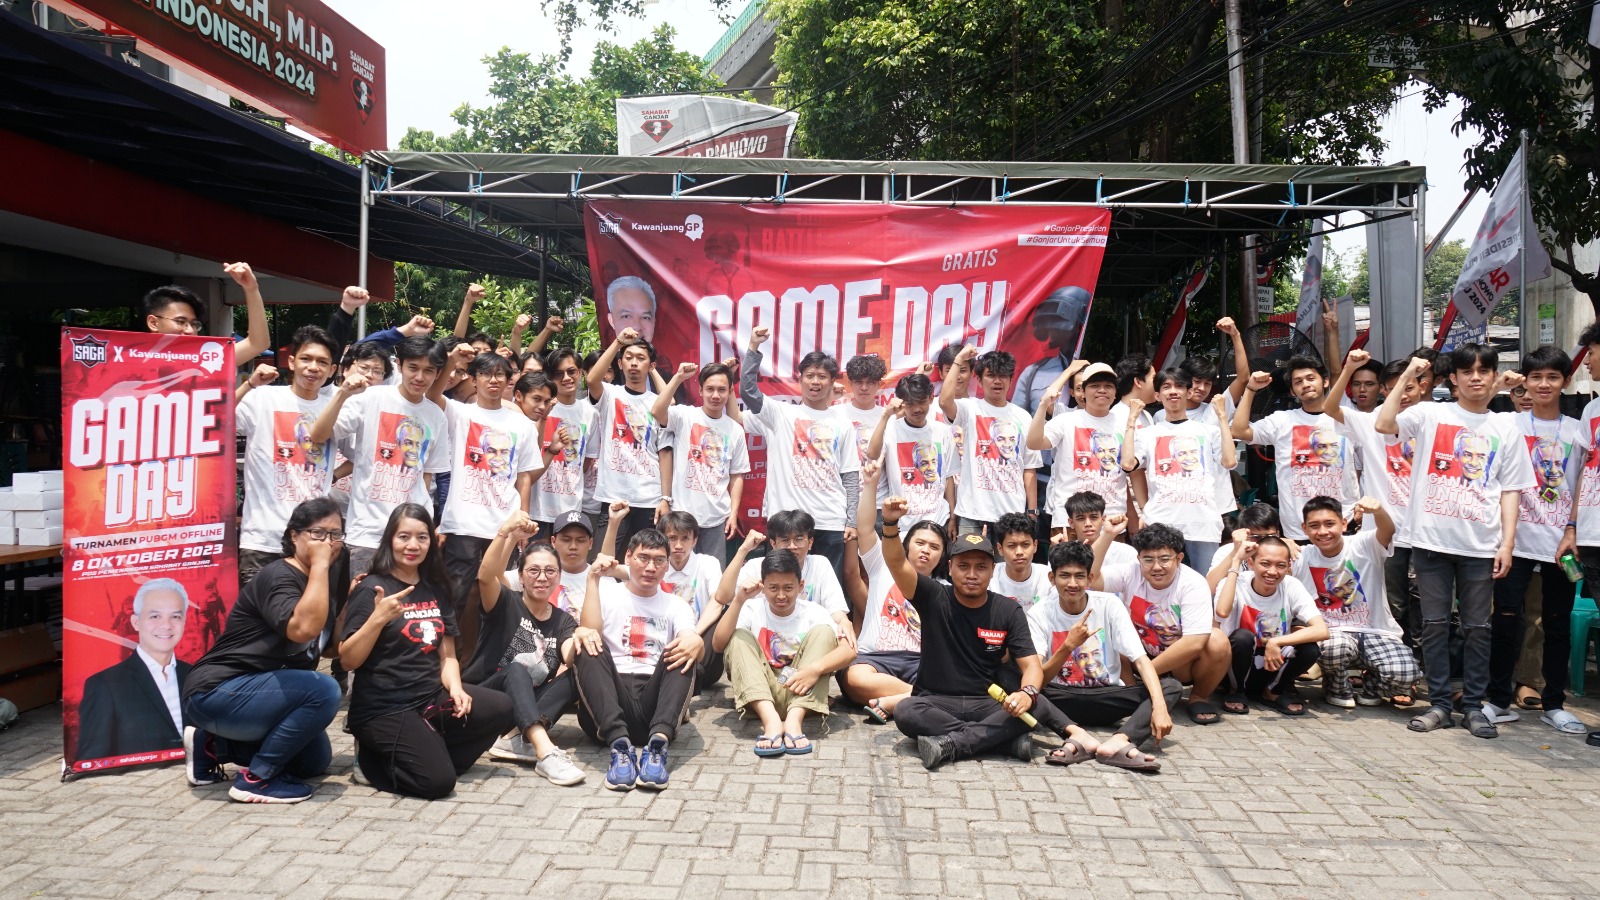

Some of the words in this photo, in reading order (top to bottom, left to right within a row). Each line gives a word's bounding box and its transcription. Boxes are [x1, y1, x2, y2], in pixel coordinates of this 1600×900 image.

[287, 10, 338, 71] M.I.P.
[275, 52, 315, 95] 2024
[349, 50, 375, 74] SAHABAT
[352, 62, 374, 83] GANJAR
[941, 248, 998, 272] GRATIS
[696, 278, 882, 378] GAME
[890, 280, 1009, 371] DAY
[75, 345, 105, 361] SAGA
[113, 346, 124, 362] X
[70, 388, 222, 467] GAME
[104, 456, 198, 527] DAY
[1423, 498, 1486, 524] SEMUA
[1519, 497, 1571, 514] NTUK
[1518, 509, 1571, 528] EMUA
[75, 537, 137, 550] TURNAMEN
[139, 533, 177, 543] PUBGM
[180, 528, 222, 539] OFFLINE
[72, 560, 85, 571] 8
[87, 549, 179, 569] OKTOBER
[181, 544, 224, 558] 2023
[404, 608, 441, 619] GANJAR
